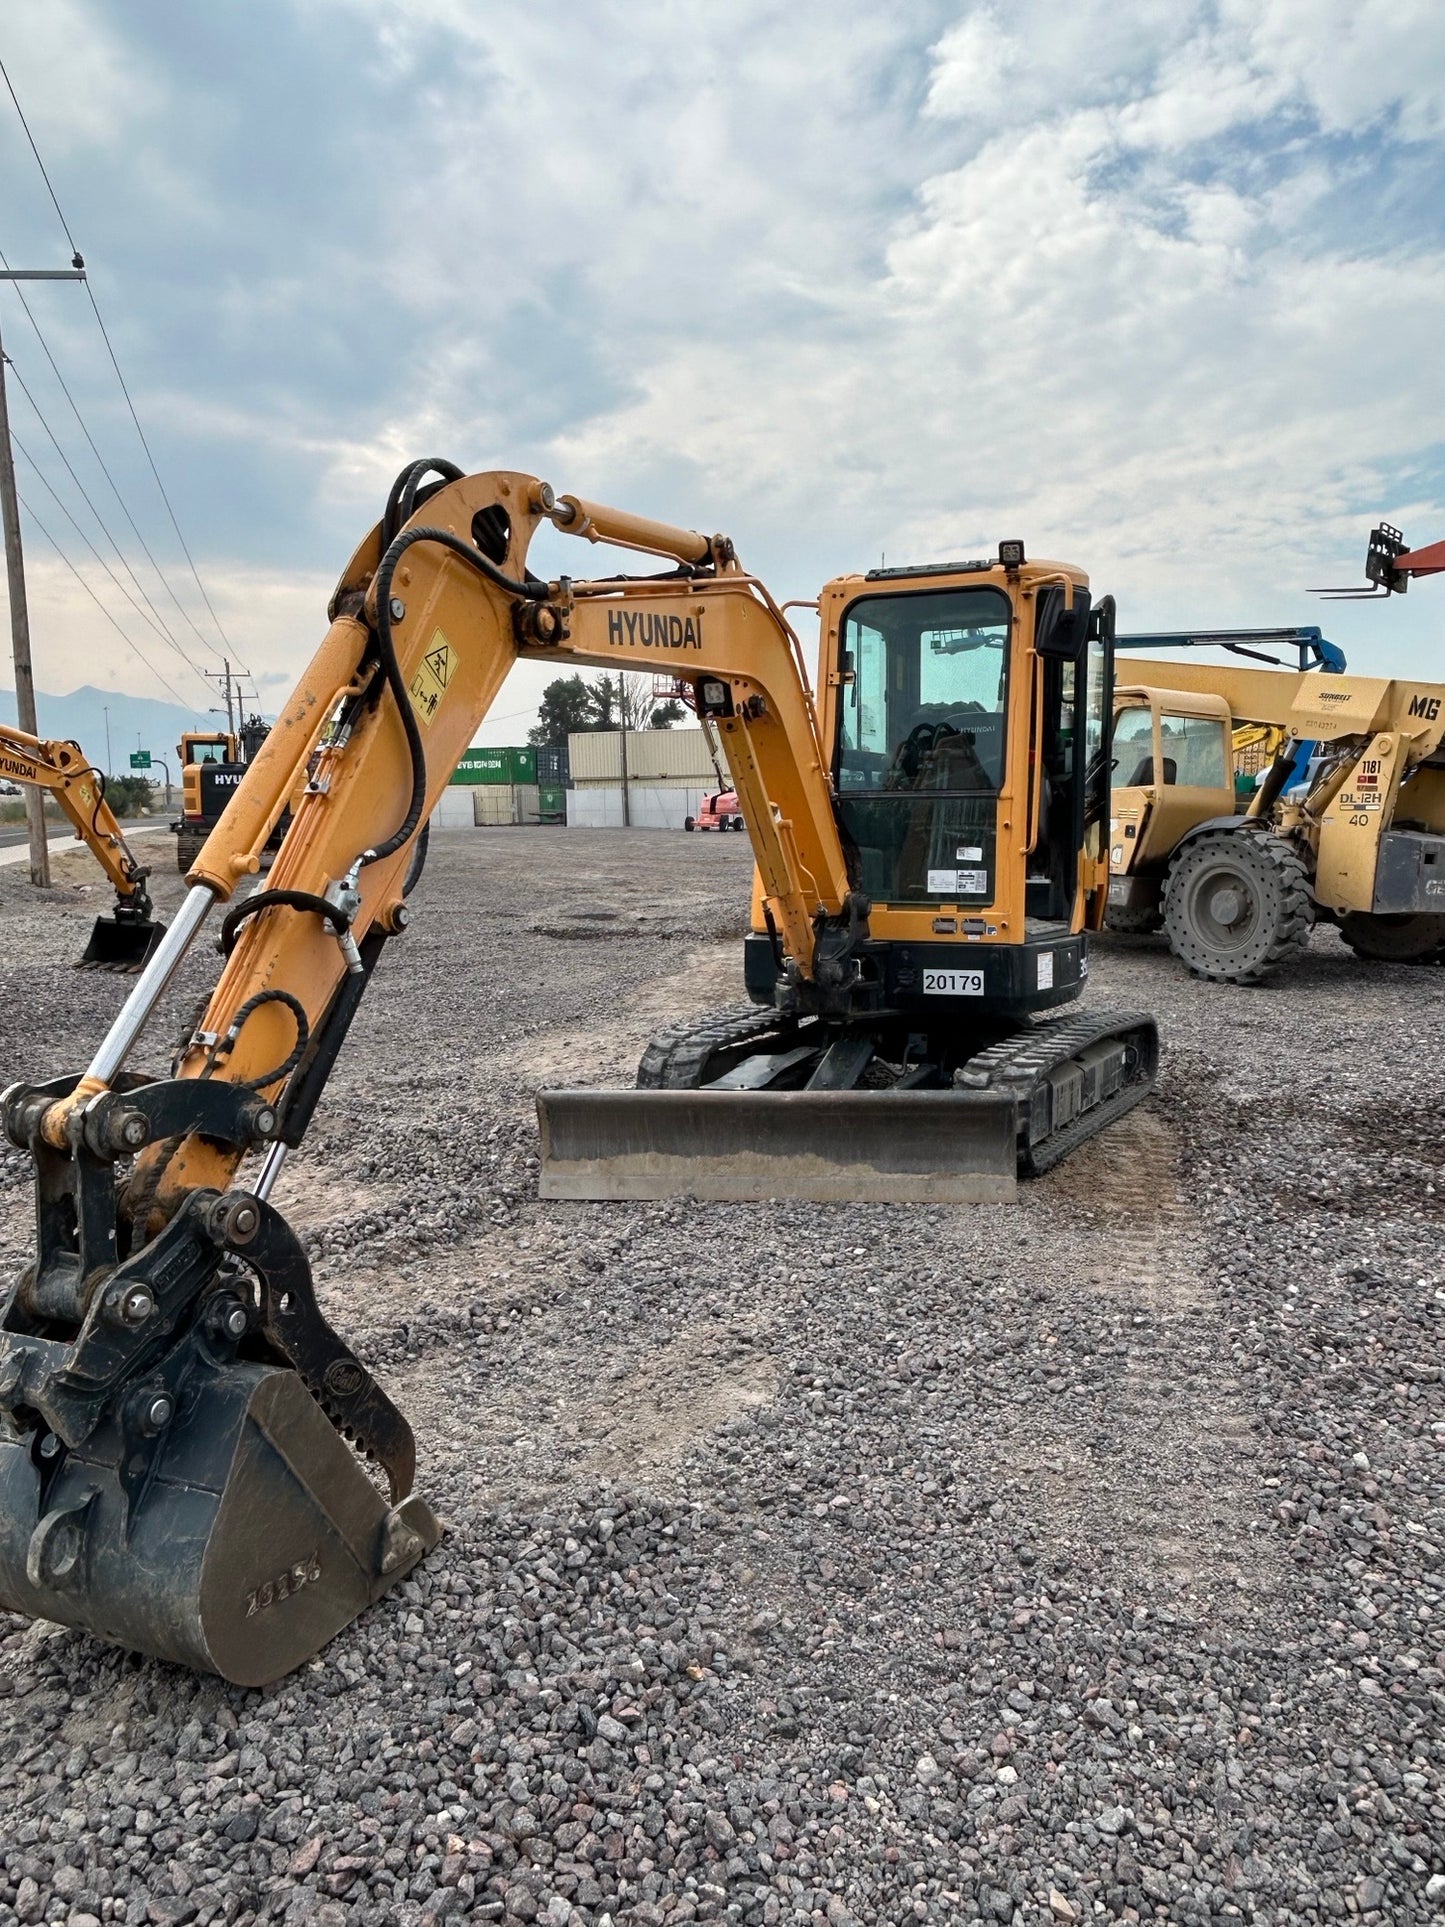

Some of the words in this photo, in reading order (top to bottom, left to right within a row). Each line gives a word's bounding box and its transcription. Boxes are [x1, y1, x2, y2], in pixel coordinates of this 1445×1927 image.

[608, 609, 703, 650] HYUNDAI
[1362, 760, 1381, 774] 1181
[1340, 793, 1382, 804] DL-12H
[1349, 814, 1369, 826] 40
[925, 974, 982, 992] 20179
